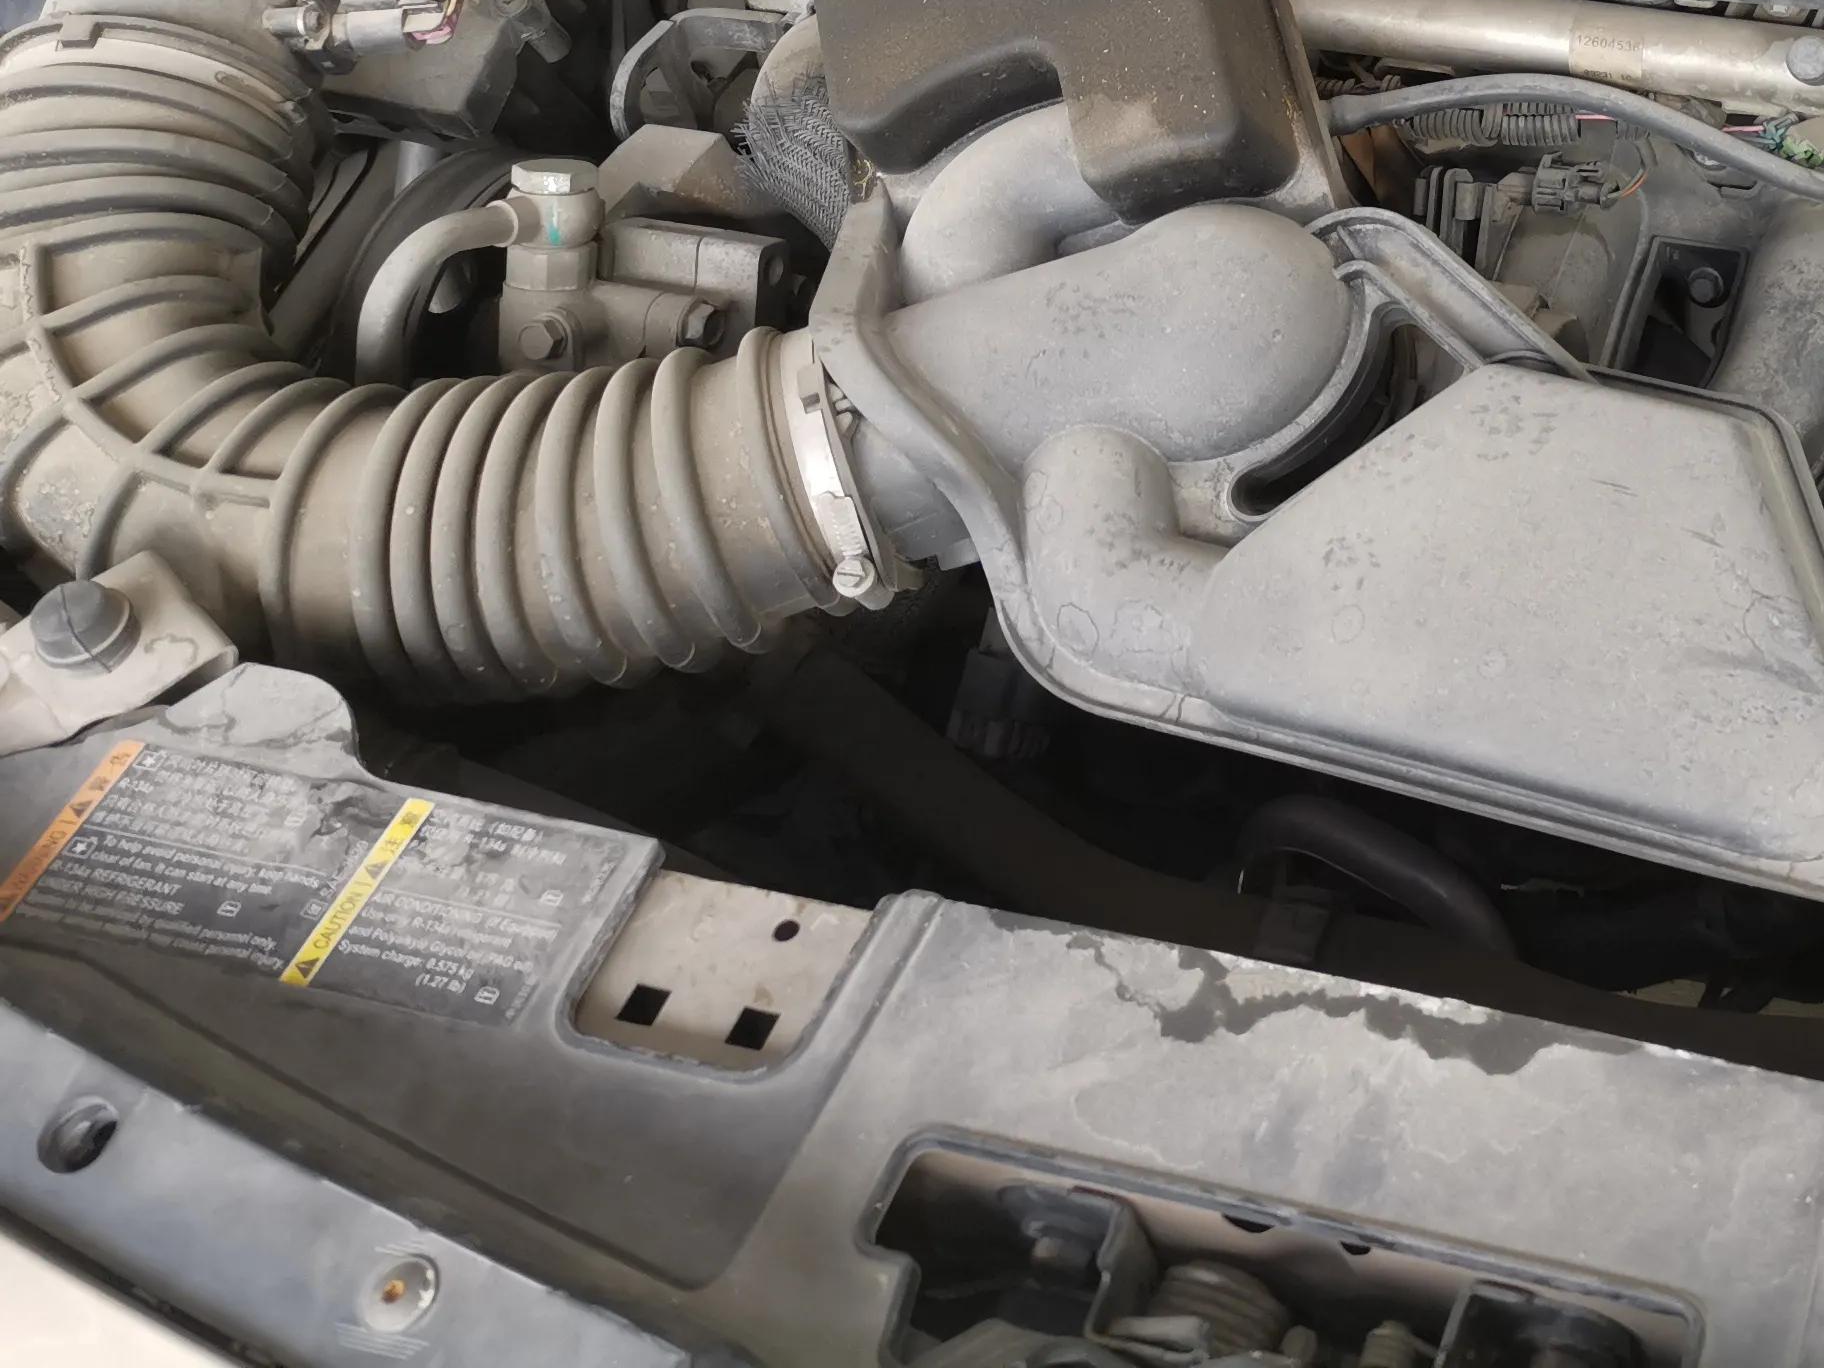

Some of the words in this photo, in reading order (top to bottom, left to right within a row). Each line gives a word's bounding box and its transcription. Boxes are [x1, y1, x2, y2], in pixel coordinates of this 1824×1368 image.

[91, 868, 183, 895] REFRIGERANT
[114, 889, 186, 915] PRESSURE
[312, 890, 363, 950] CAUTION
[457, 963, 476, 981] kg
